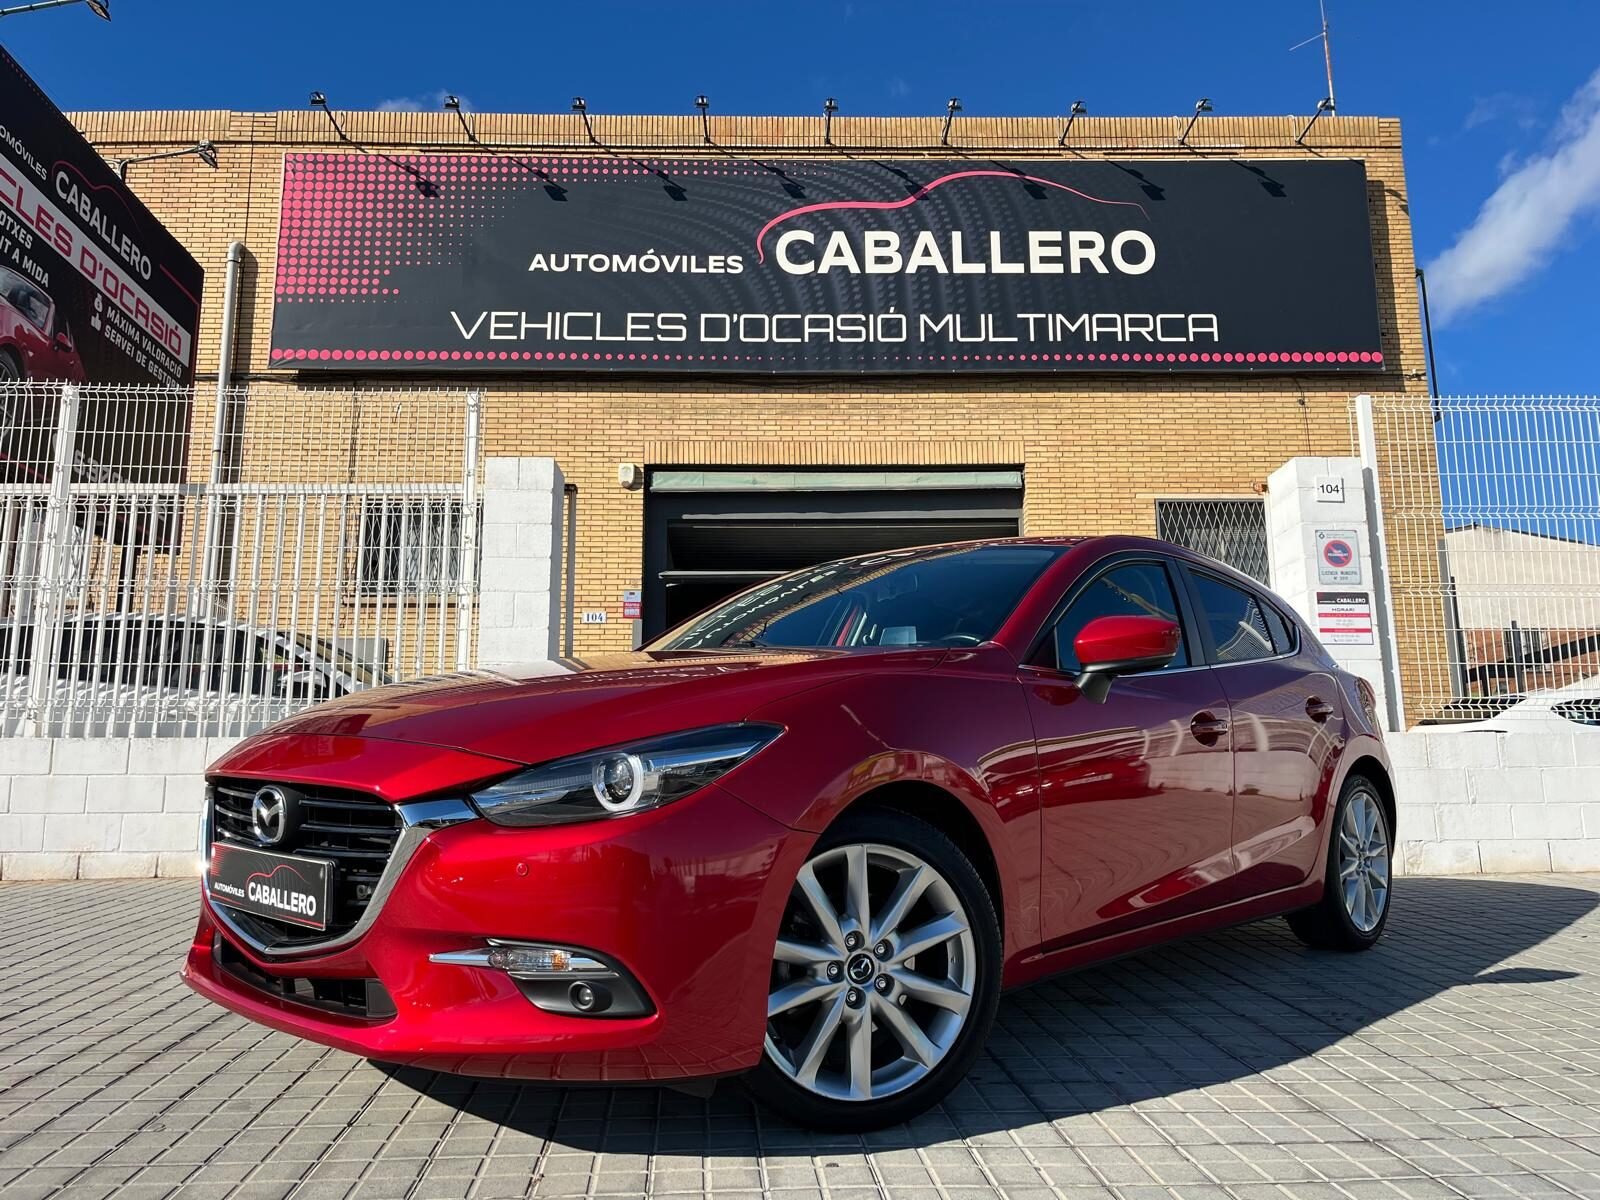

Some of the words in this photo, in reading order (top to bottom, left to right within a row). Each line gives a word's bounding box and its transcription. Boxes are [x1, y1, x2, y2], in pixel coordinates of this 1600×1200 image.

[55, 171, 152, 281] CABALLERO
[11, 248, 20, 264] A
[22, 255, 49, 288] MIDA
[529, 248, 744, 275] AUTOMÓVILES
[775, 229, 1156, 276] CABALLERO
[80, 245, 182, 357] D'OCASIÓ
[451, 310, 687, 342] VEHICLES
[701, 306, 907, 343] D'OCASIÓ
[919, 313, 1219, 343] MULTIMARCA
[104, 324, 135, 358] SERVEI
[136, 350, 148, 368] DE
[142, 336, 182, 379] VALORACIÓ
[1320, 484, 1340, 494] 104
[586, 613, 603, 622] 104
[215, 882, 245, 898] AUTOMÓVILES
[248, 882, 317, 916] CABALLERO
